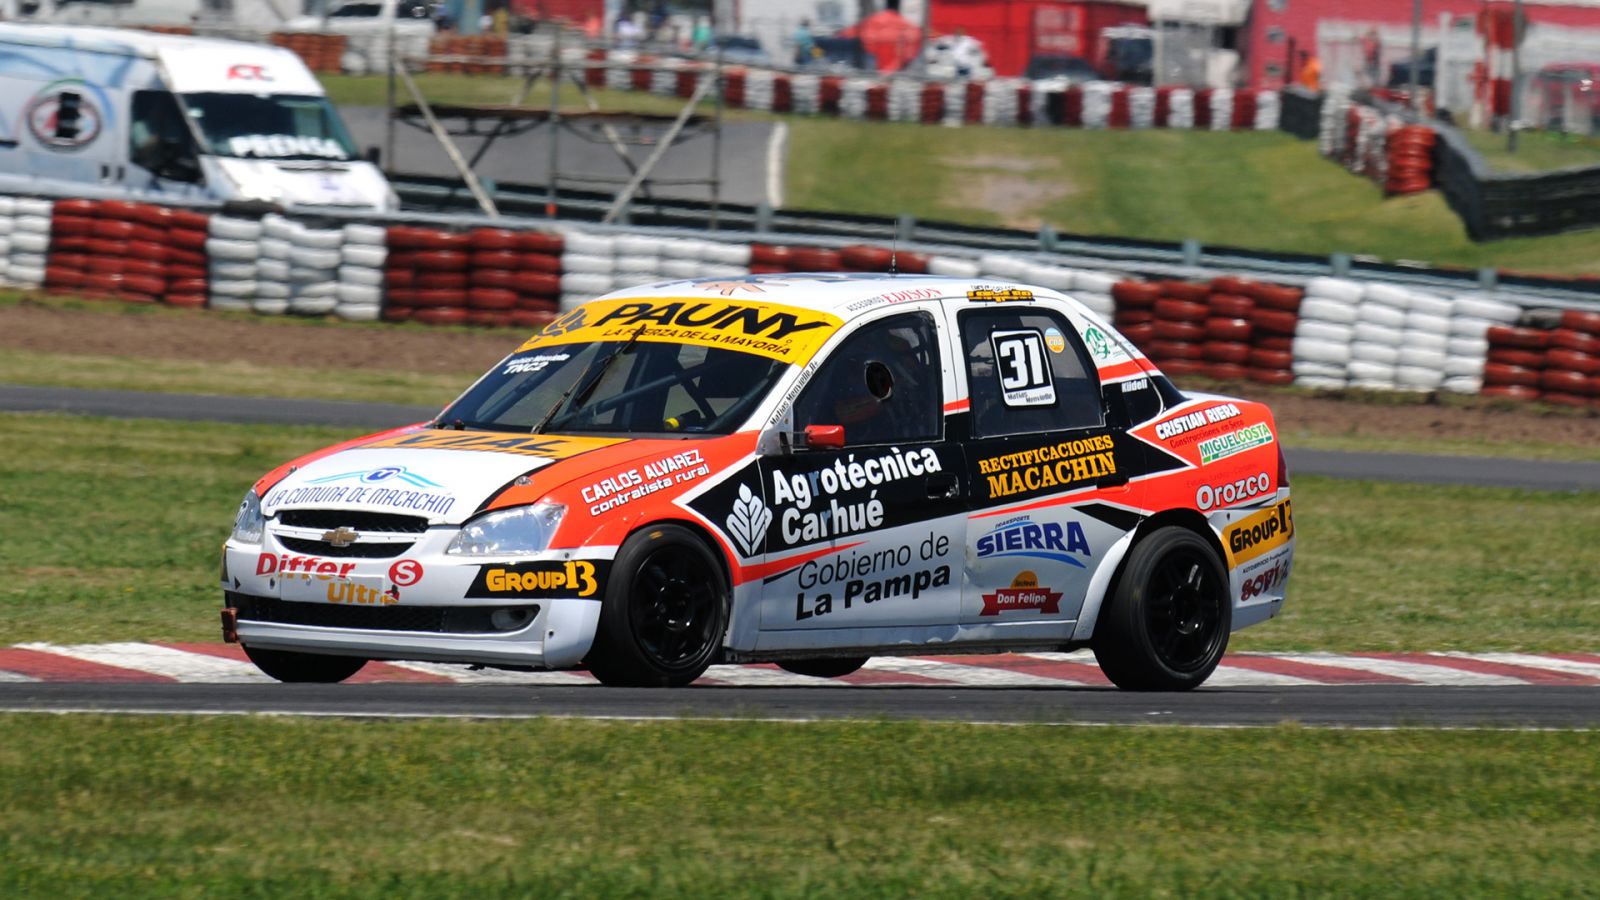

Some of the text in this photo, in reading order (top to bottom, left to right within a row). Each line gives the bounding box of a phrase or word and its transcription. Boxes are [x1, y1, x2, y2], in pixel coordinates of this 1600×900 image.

[229, 134, 348, 160] PRENSA
[881, 287, 943, 304] EDISON
[590, 302, 833, 341] PAUNY
[679, 330, 701, 340] DE
[703, 332, 721, 341] LA
[1000, 337, 1044, 390] 31
[1155, 403, 1242, 440] CRISTIAN RIERA
[978, 435, 1114, 475] RECTIFICACIONES
[581, 449, 705, 504] CARLOS ALVAREZ
[590, 463, 710, 516] contratista rural
[772, 446, 942, 510] Agrotécnica
[987, 451, 1117, 498] MACACHIN
[1196, 472, 1270, 510] Orozco
[267, 489, 288, 507] LA
[284, 486, 349, 505] COMUNA
[346, 486, 372, 504] DE
[781, 490, 884, 546] Carhué
[995, 514, 1030, 529] TRANSPORTE
[977, 521, 1092, 557] SIERRA
[256, 552, 356, 579] Differ
[799, 531, 950, 590] Gobierno de
[796, 564, 951, 622] La Pampa
[997, 592, 1047, 606] Don Felipe
